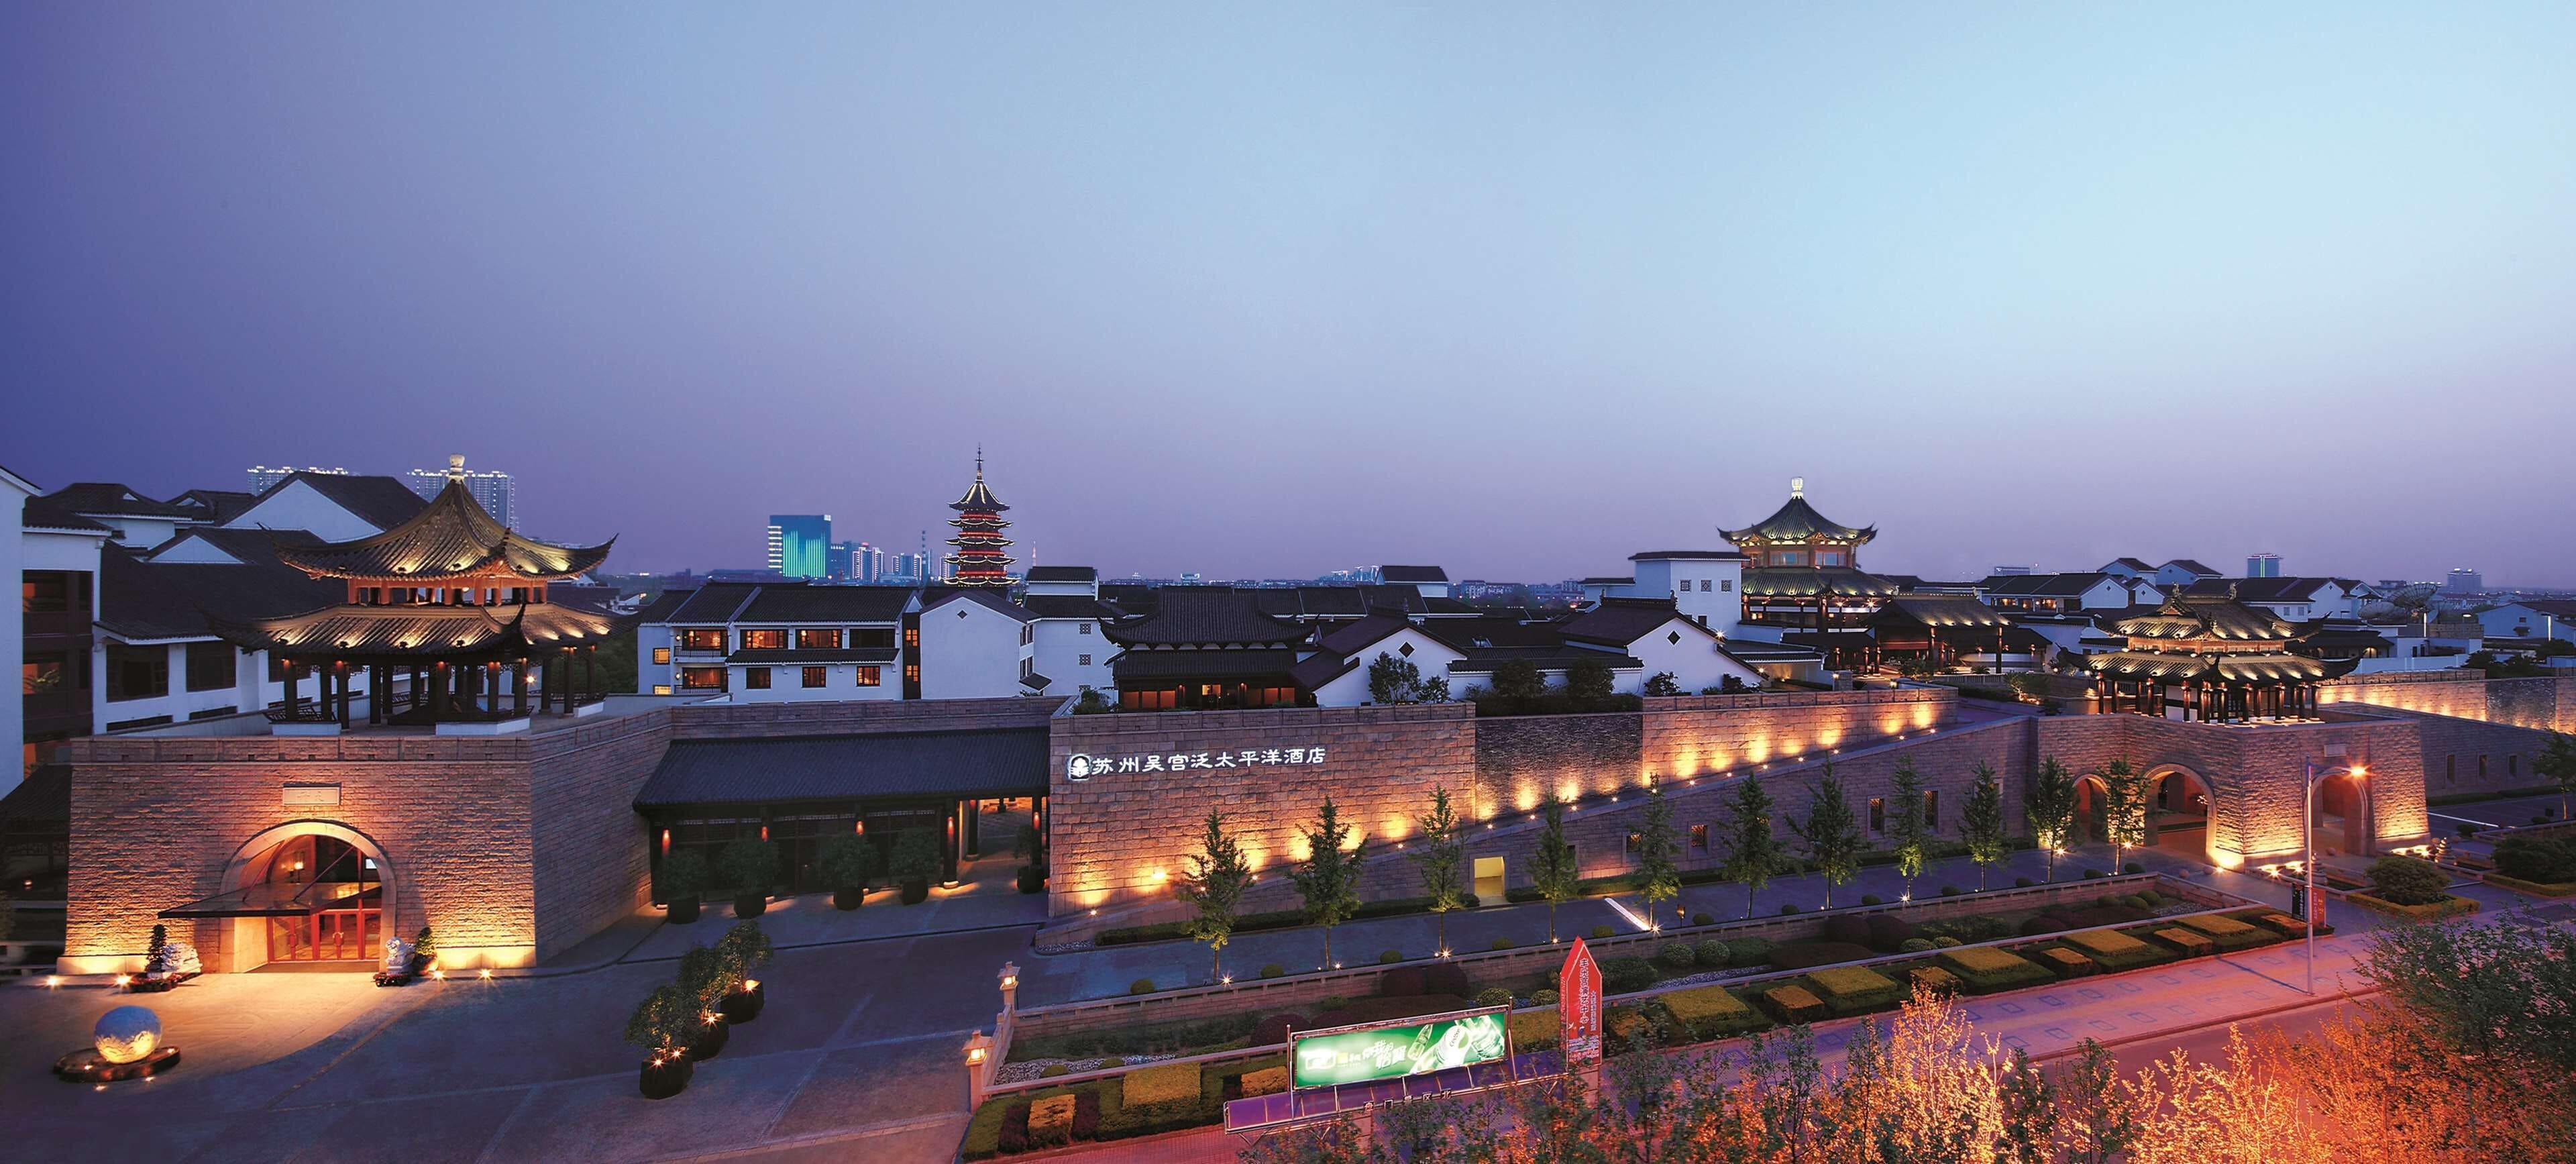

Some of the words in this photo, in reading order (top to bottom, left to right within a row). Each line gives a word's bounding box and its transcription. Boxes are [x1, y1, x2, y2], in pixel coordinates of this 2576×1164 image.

[1091, 747, 1326, 775] 苏州吴宫泛太平洋酒店
